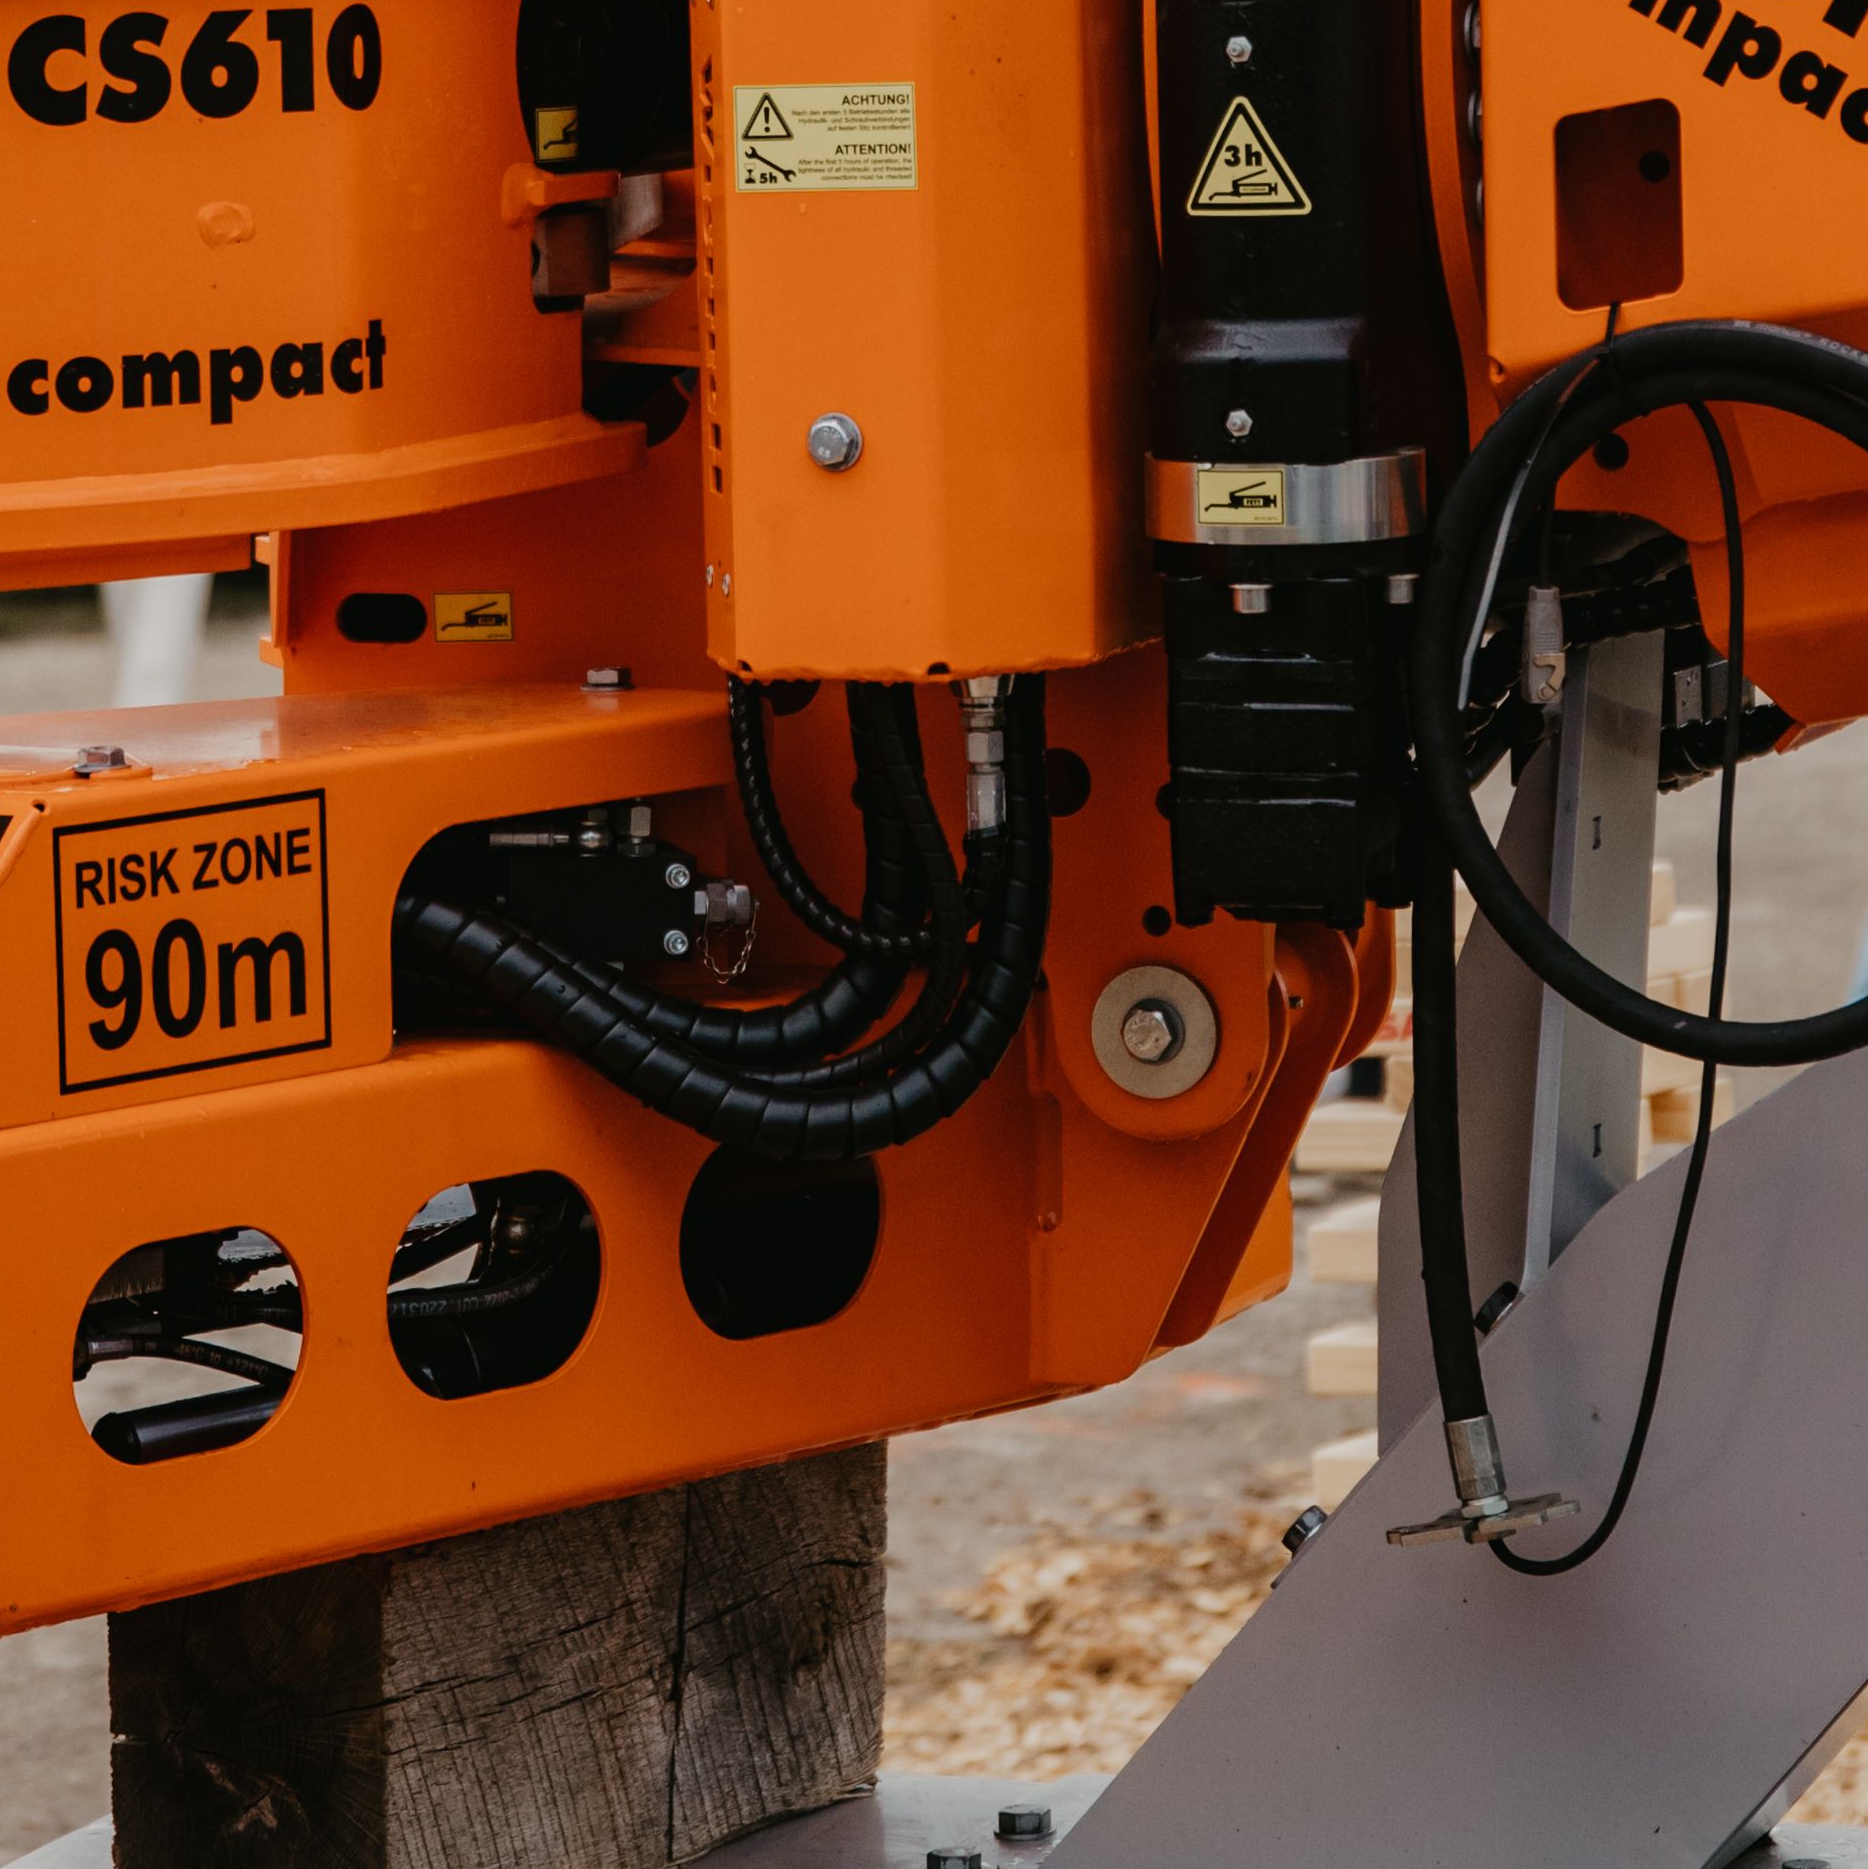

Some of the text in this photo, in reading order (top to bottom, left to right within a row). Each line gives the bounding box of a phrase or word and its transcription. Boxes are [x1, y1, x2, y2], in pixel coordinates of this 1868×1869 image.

[7, 2, 383, 127] CS610
[841, 94, 910, 106] ACHTUNG!
[835, 144, 911, 156] ATTENTION!
[7, 319, 387, 425] compact
[74, 824, 313, 909] RISK ZONE
[83, 918, 309, 1051] 90m
